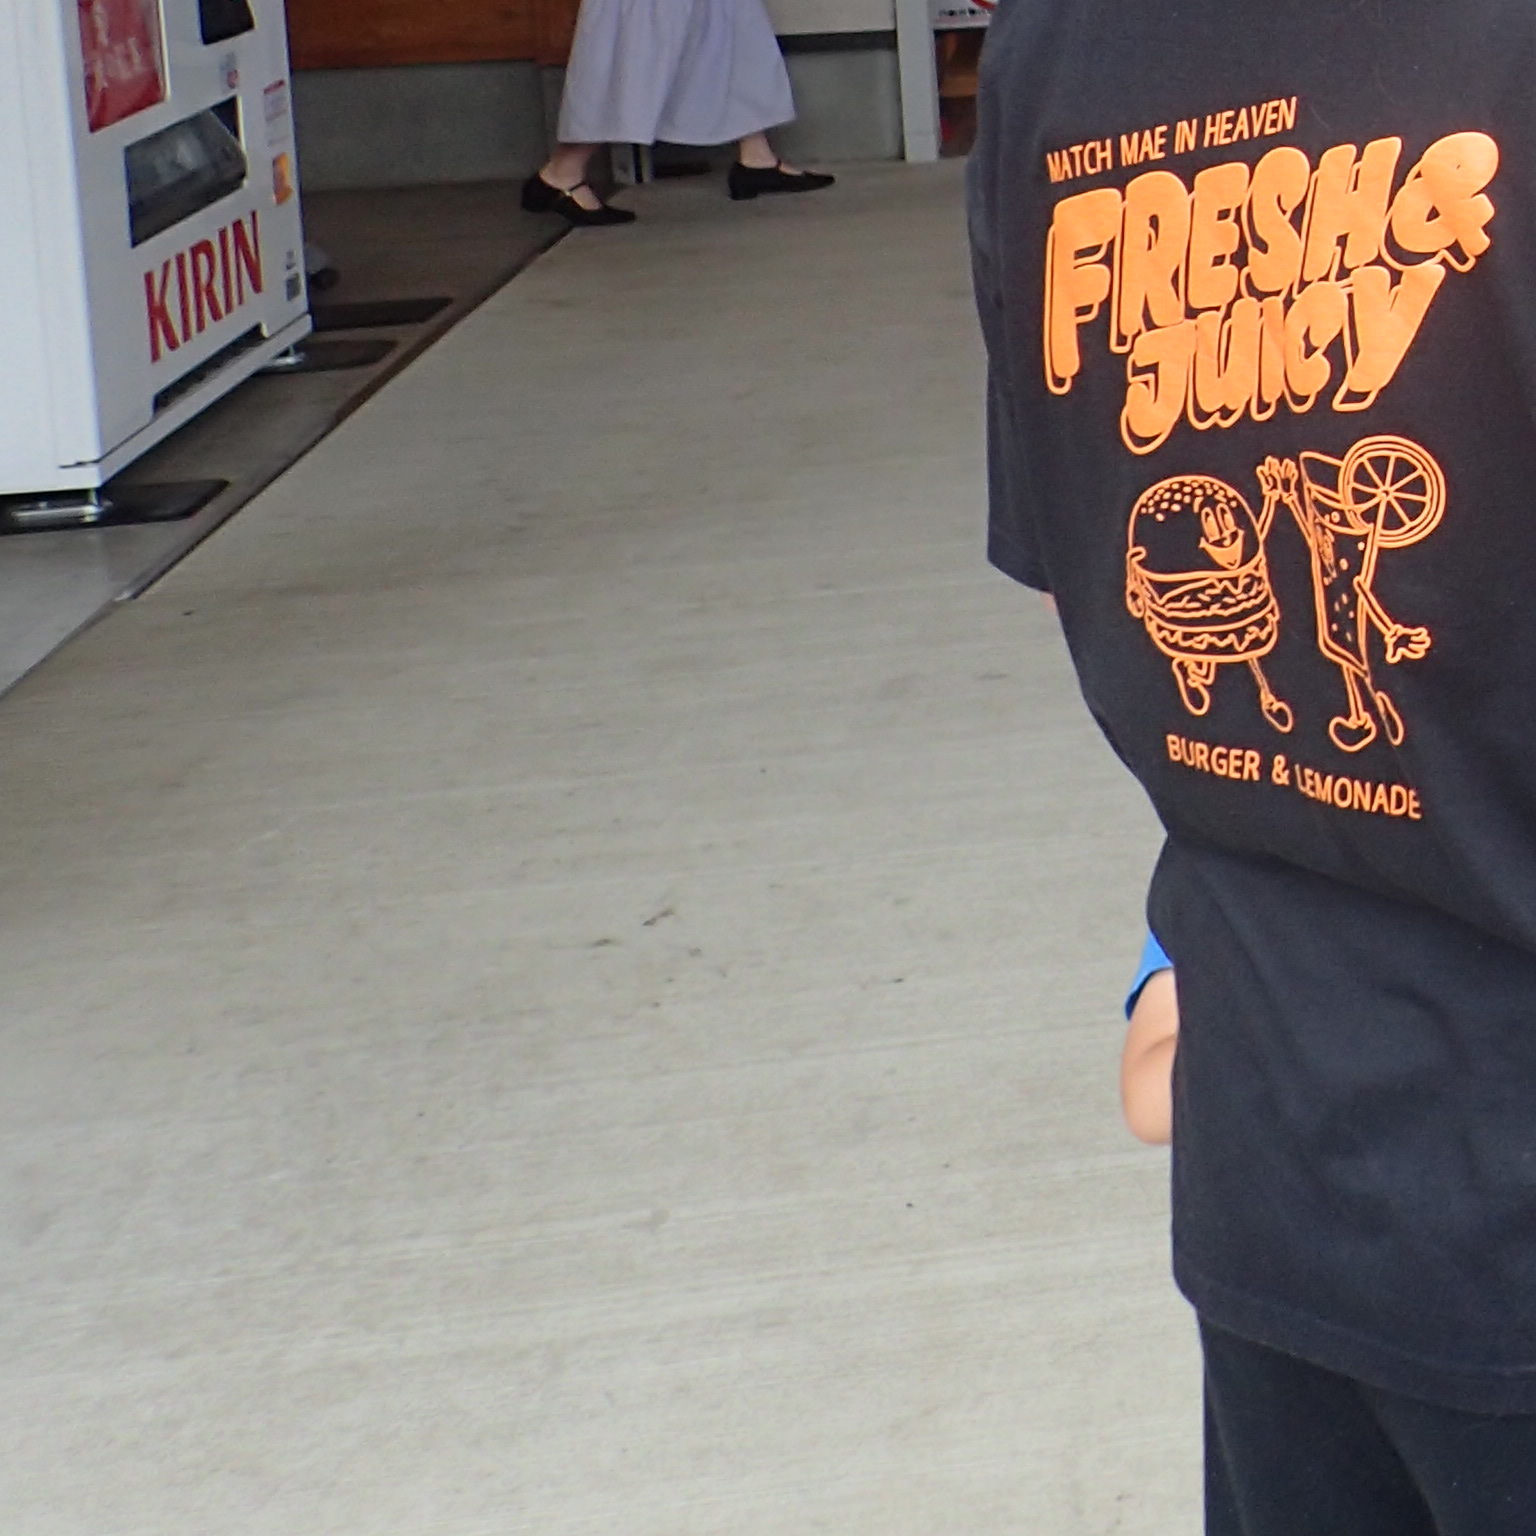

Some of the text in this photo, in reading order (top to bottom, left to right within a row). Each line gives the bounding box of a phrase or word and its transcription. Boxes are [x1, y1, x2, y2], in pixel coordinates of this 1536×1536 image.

[1174, 118, 1197, 155] IN
[1203, 97, 1297, 148] HEAVEN
[143, 210, 263, 364] KIRIN
[1045, 131, 1498, 394] FRESH &
[1120, 263, 1446, 454] JUICY
[1166, 734, 1422, 820] BURGER & LEMONADE
